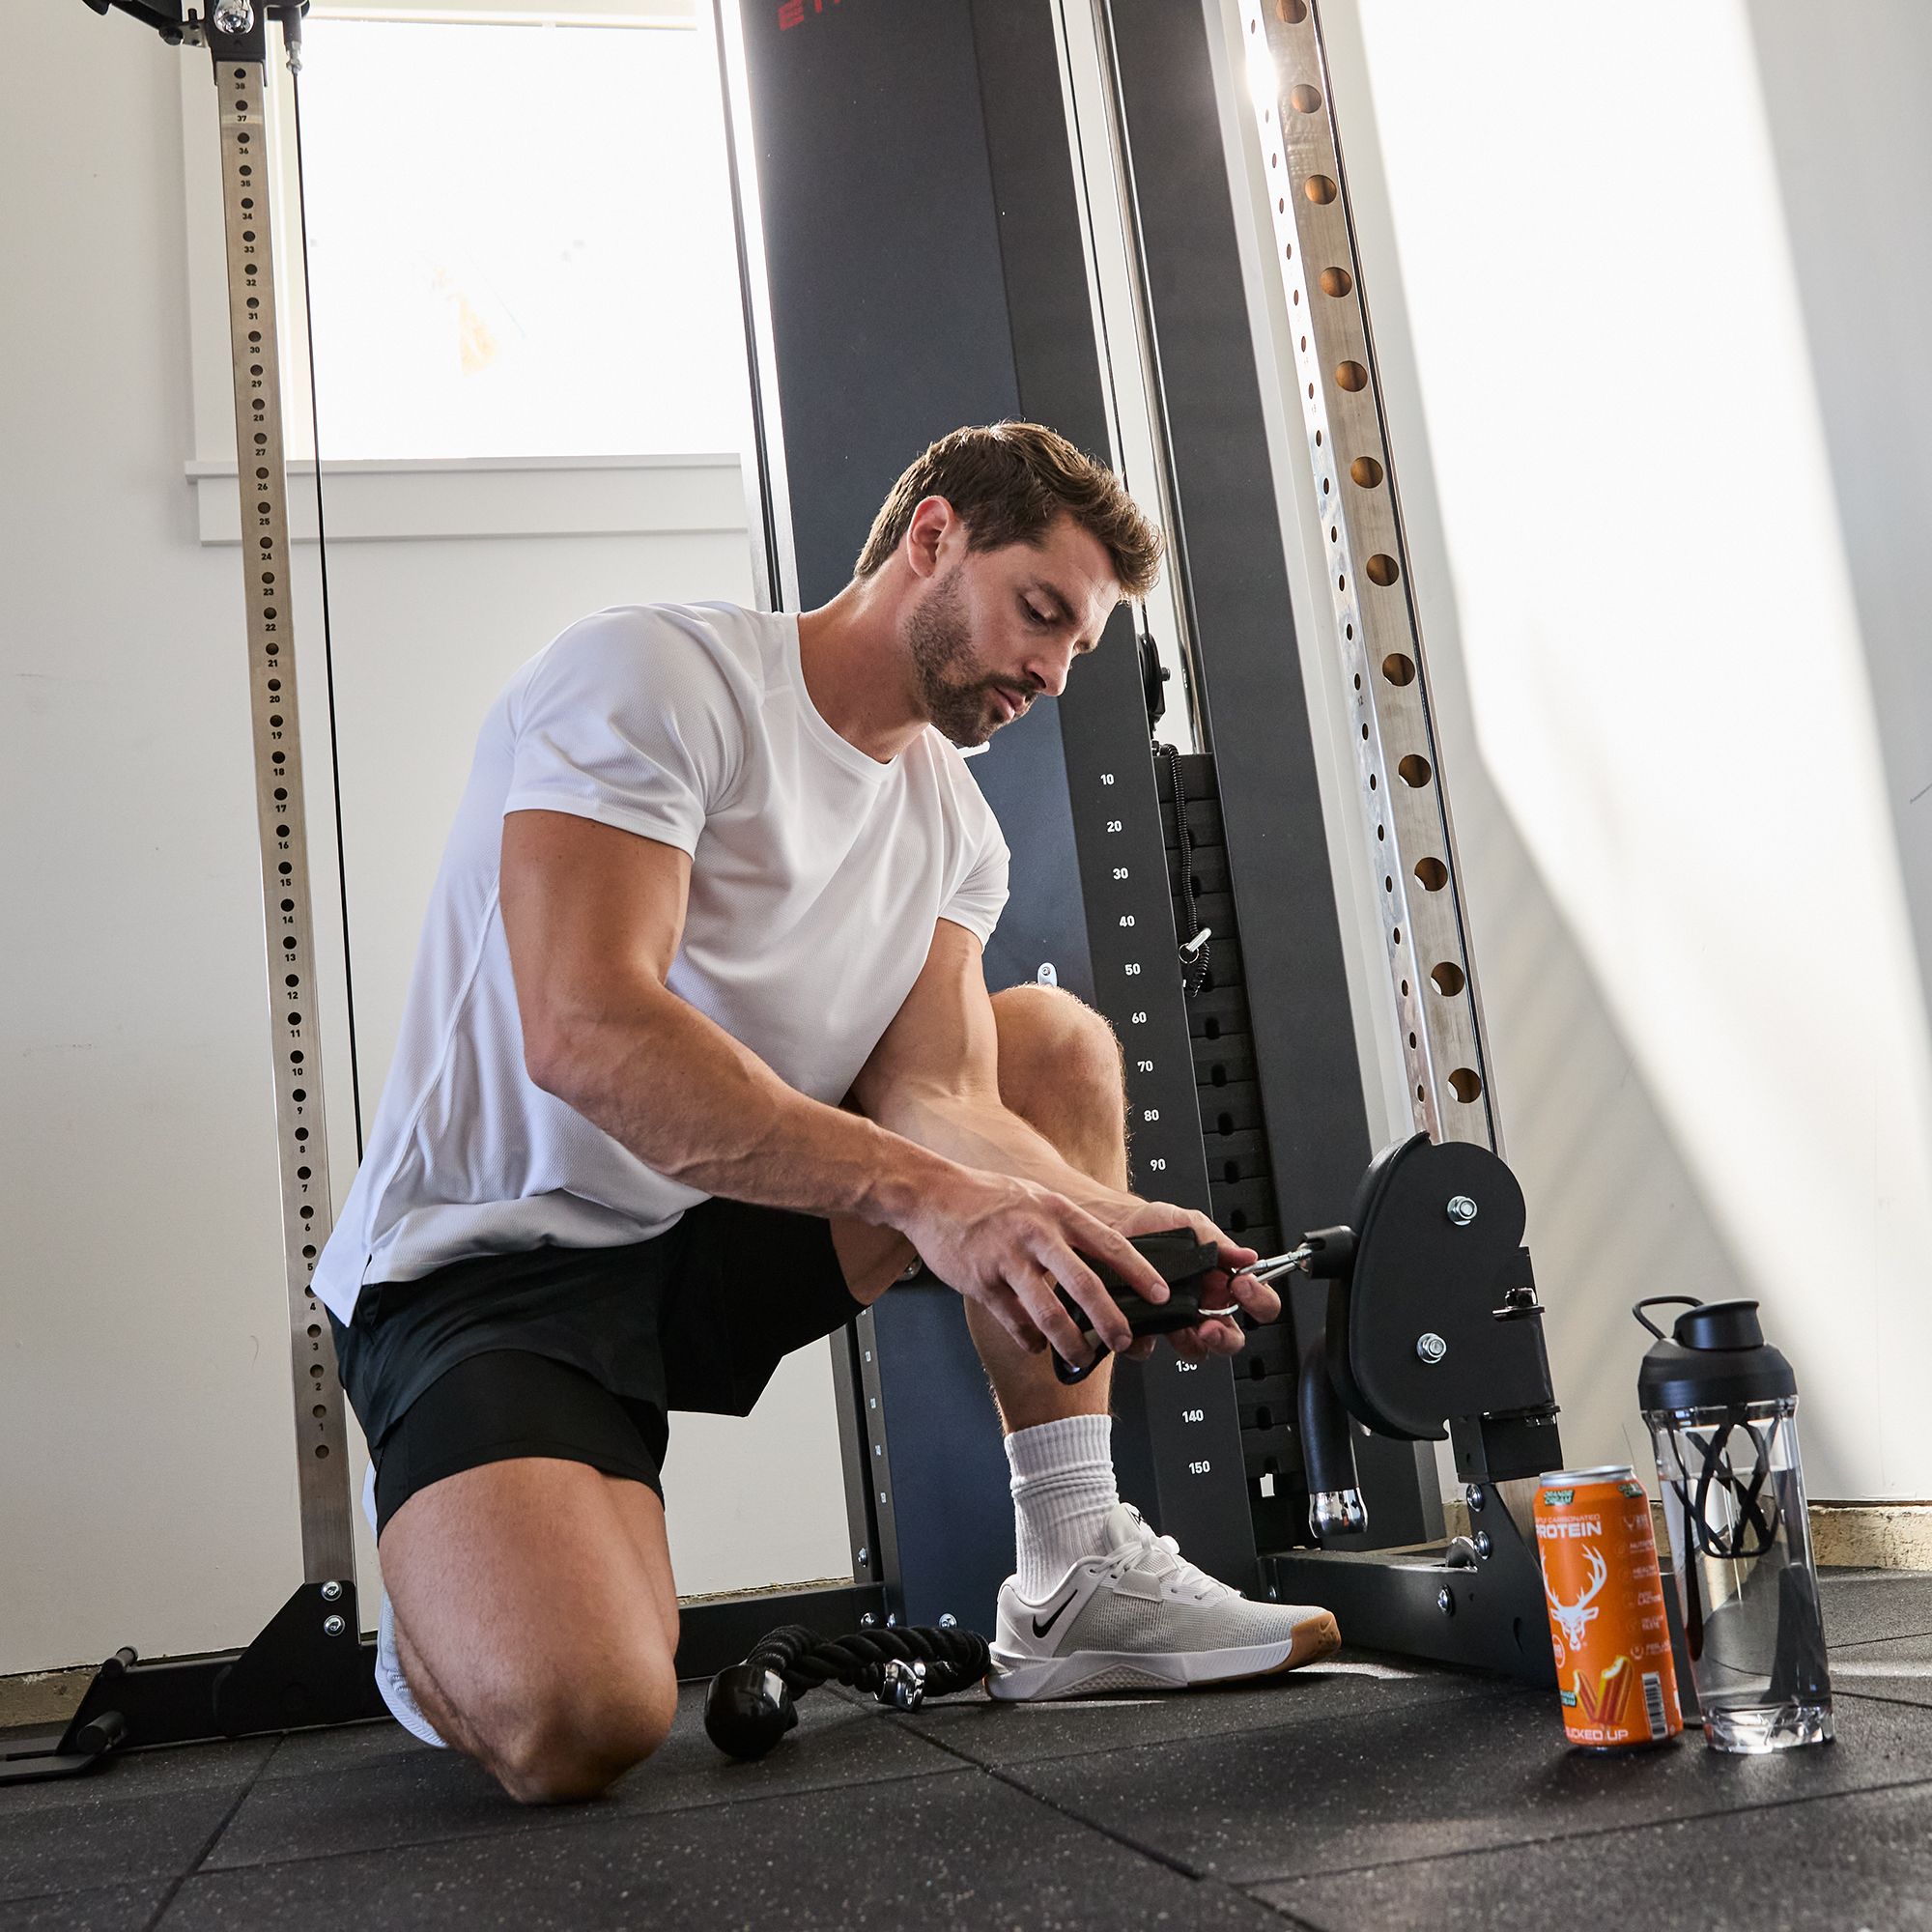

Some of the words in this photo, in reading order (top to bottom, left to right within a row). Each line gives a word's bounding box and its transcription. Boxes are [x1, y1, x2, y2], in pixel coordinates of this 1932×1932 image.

[243, 245, 255, 254] 33
[245, 278, 257, 287] 32
[248, 312, 259, 321] 31
[249, 346, 261, 355] 30
[251, 380, 263, 388] 29
[253, 413, 265, 422] 28
[255, 448, 267, 457] 27
[257, 482, 269, 492] 26
[259, 517, 270, 526] 25
[261, 553, 272, 561] 24
[263, 587, 274, 596] 23
[265, 623, 276, 632] 22
[268, 659, 278, 668] 21
[269, 695, 281, 704] 20
[270, 730, 283, 740] 19
[272, 767, 285, 777] 18
[1100, 773, 1115, 785] 10
[275, 804, 287, 813] 17
[1106, 820, 1122, 833] 20
[277, 840, 290, 850] 16
[1112, 867, 1129, 880] 30
[279, 878, 292, 887] 15
[282, 915, 294, 924] 14
[1119, 915, 1135, 927] 40
[284, 952, 297, 962] 13
[1124, 962, 1141, 976] 50
[287, 990, 298, 1000] 12
[1131, 1011, 1148, 1024] 60
[290, 1029, 300, 1038] 11
[292, 1067, 303, 1076] 10
[1137, 1060, 1153, 1073] 70
[297, 1106, 303, 1115] 9
[1144, 1109, 1160, 1122] 80
[299, 1145, 306, 1154] 8
[1150, 1158, 1166, 1172] 90
[301, 1183, 308, 1193] 7
[304, 1223, 311, 1233] 6
[307, 1263, 314, 1271] 5
[309, 1301, 317, 1311] 4
[312, 1342, 319, 1351] 3
[315, 1381, 322, 1392] 2
[1181, 1408, 1205, 1423] 140
[319, 1422, 324, 1432] 1
[1188, 1460, 1211, 1475] 150
[1564, 1725, 1604, 1742] UCKED
[1606, 1729, 1629, 1742] UP
